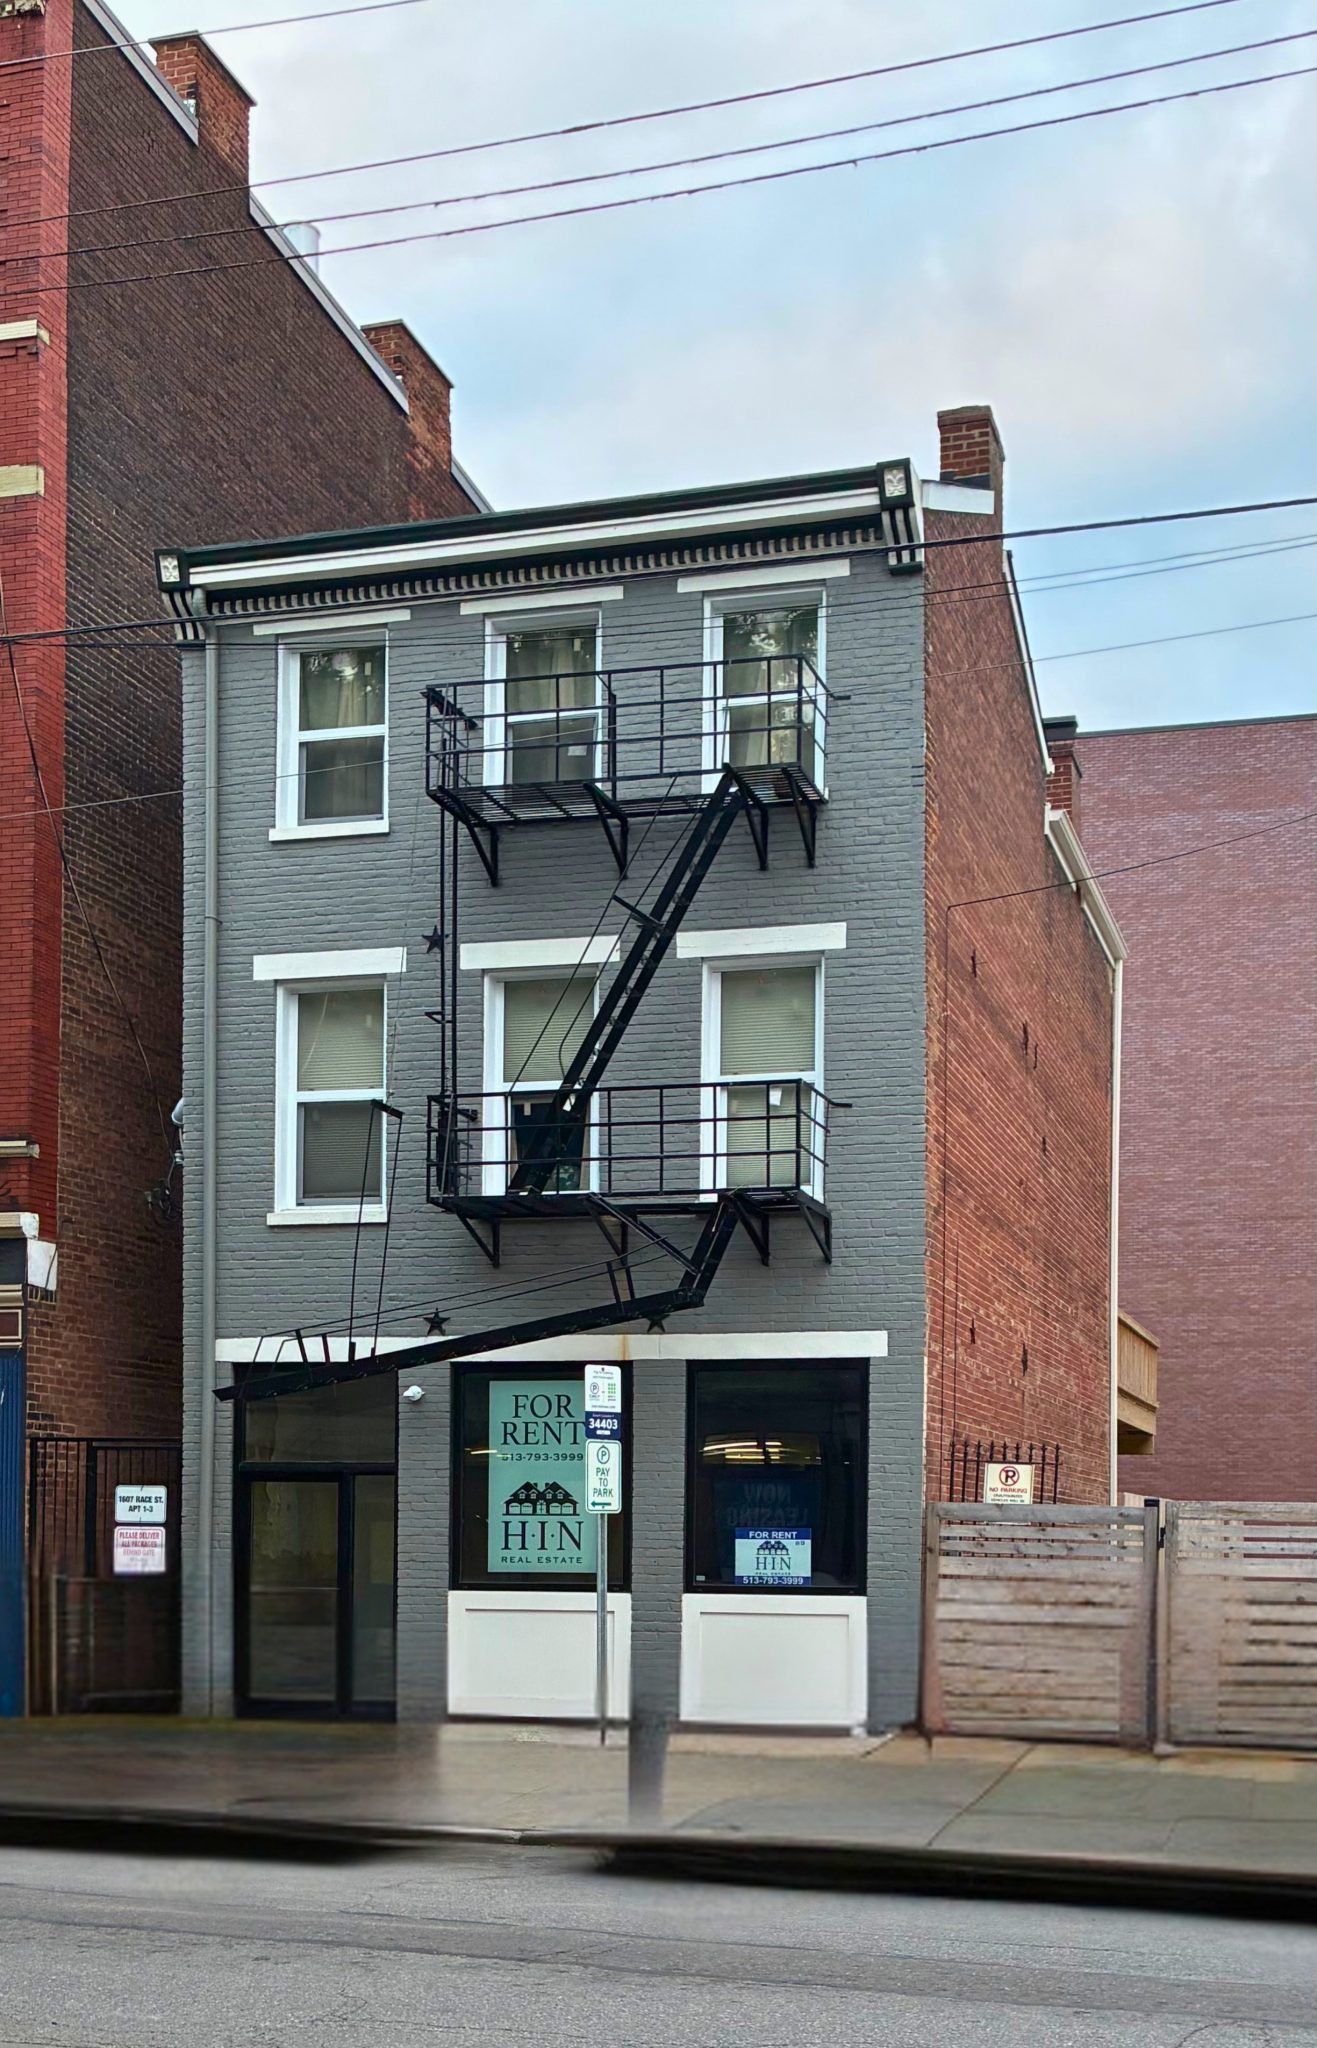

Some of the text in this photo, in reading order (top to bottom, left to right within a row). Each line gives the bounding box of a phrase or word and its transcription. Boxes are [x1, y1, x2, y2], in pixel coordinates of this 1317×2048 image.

[512, 1394, 575, 1418] FOR
[588, 1418, 618, 1429] 34403
[500, 1421, 585, 1445] RENT
[501, 1453, 584, 1461] 513-793-3999
[595, 1467, 610, 1477] PAY
[599, 1477, 608, 1487] TO
[592, 1488, 613, 1497] PARK
[742, 1576, 804, 1584] 513-793-3999
